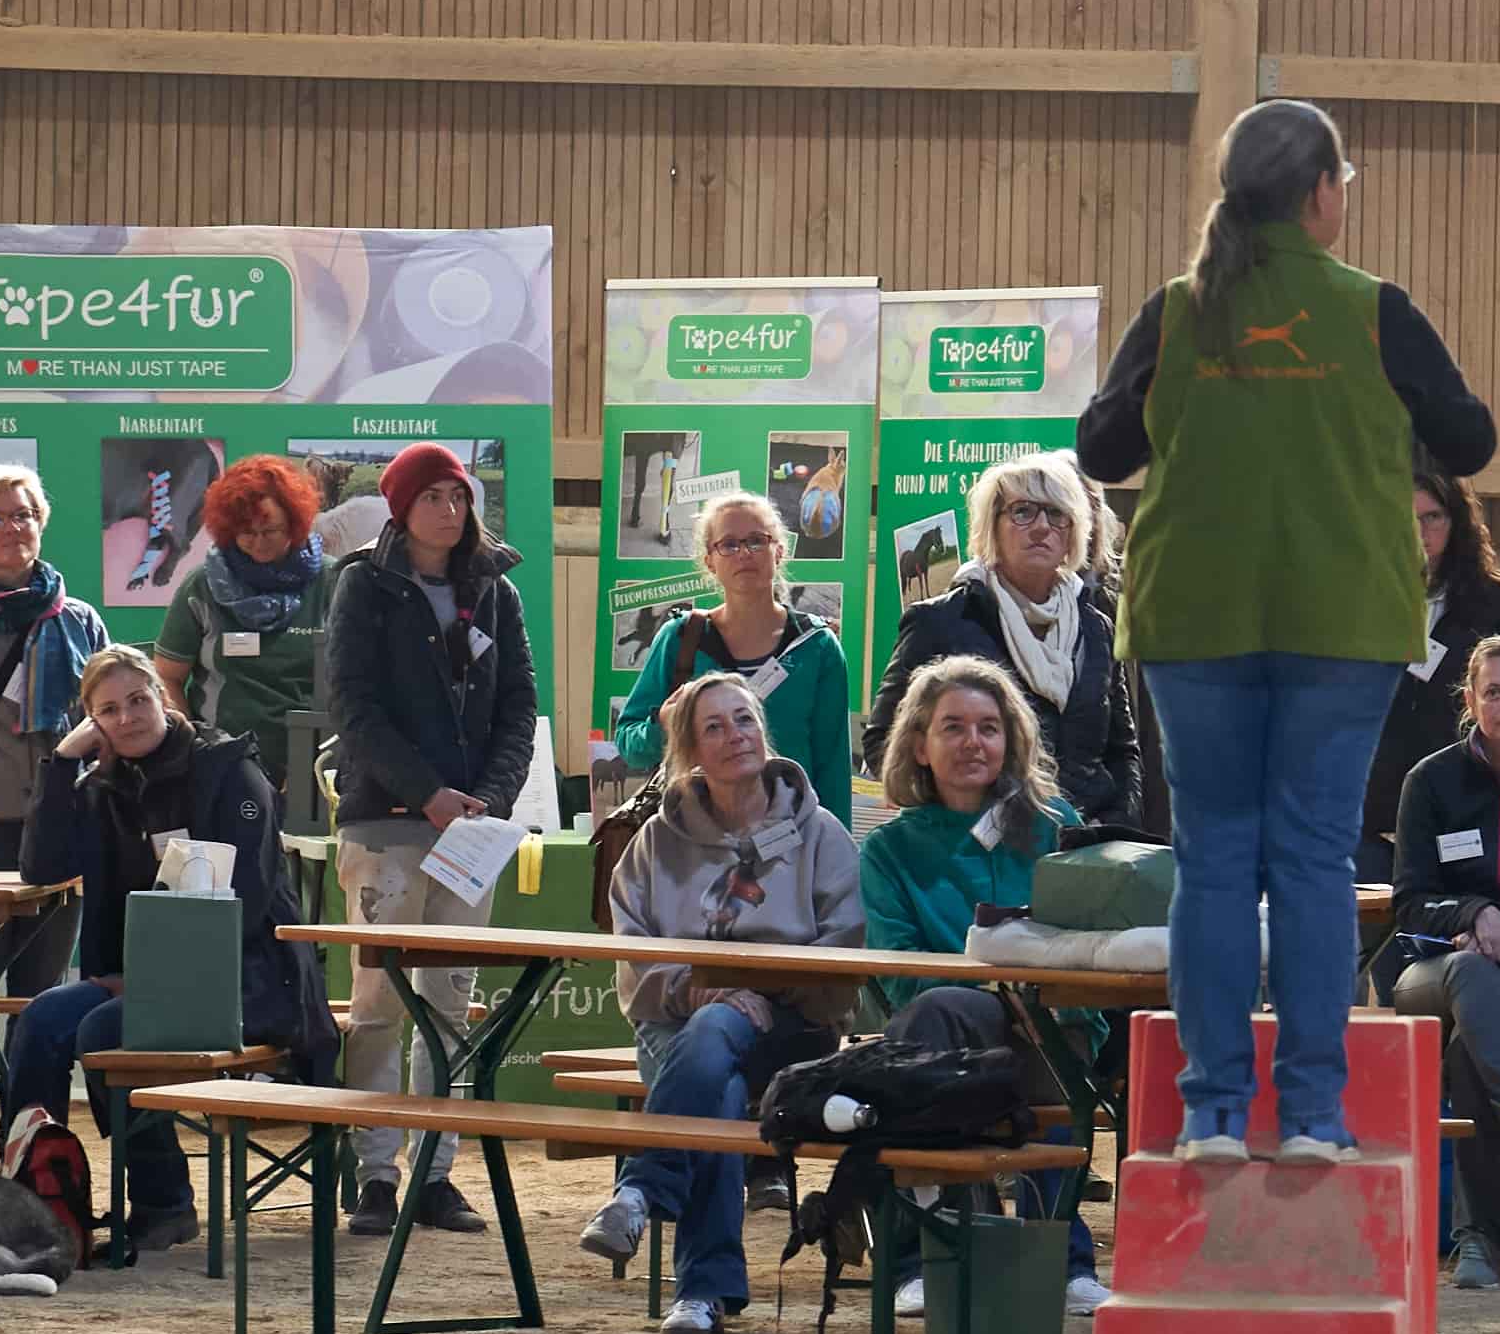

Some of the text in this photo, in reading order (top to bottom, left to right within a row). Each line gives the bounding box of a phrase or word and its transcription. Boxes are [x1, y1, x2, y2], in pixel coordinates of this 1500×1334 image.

[70, 360, 121, 376] THAN
[126, 361, 174, 376] JUST
[178, 361, 227, 377] TAPE
[719, 364, 741, 374] THAN
[764, 364, 785, 374] TAPE
[894, 474, 926, 495] RUND
